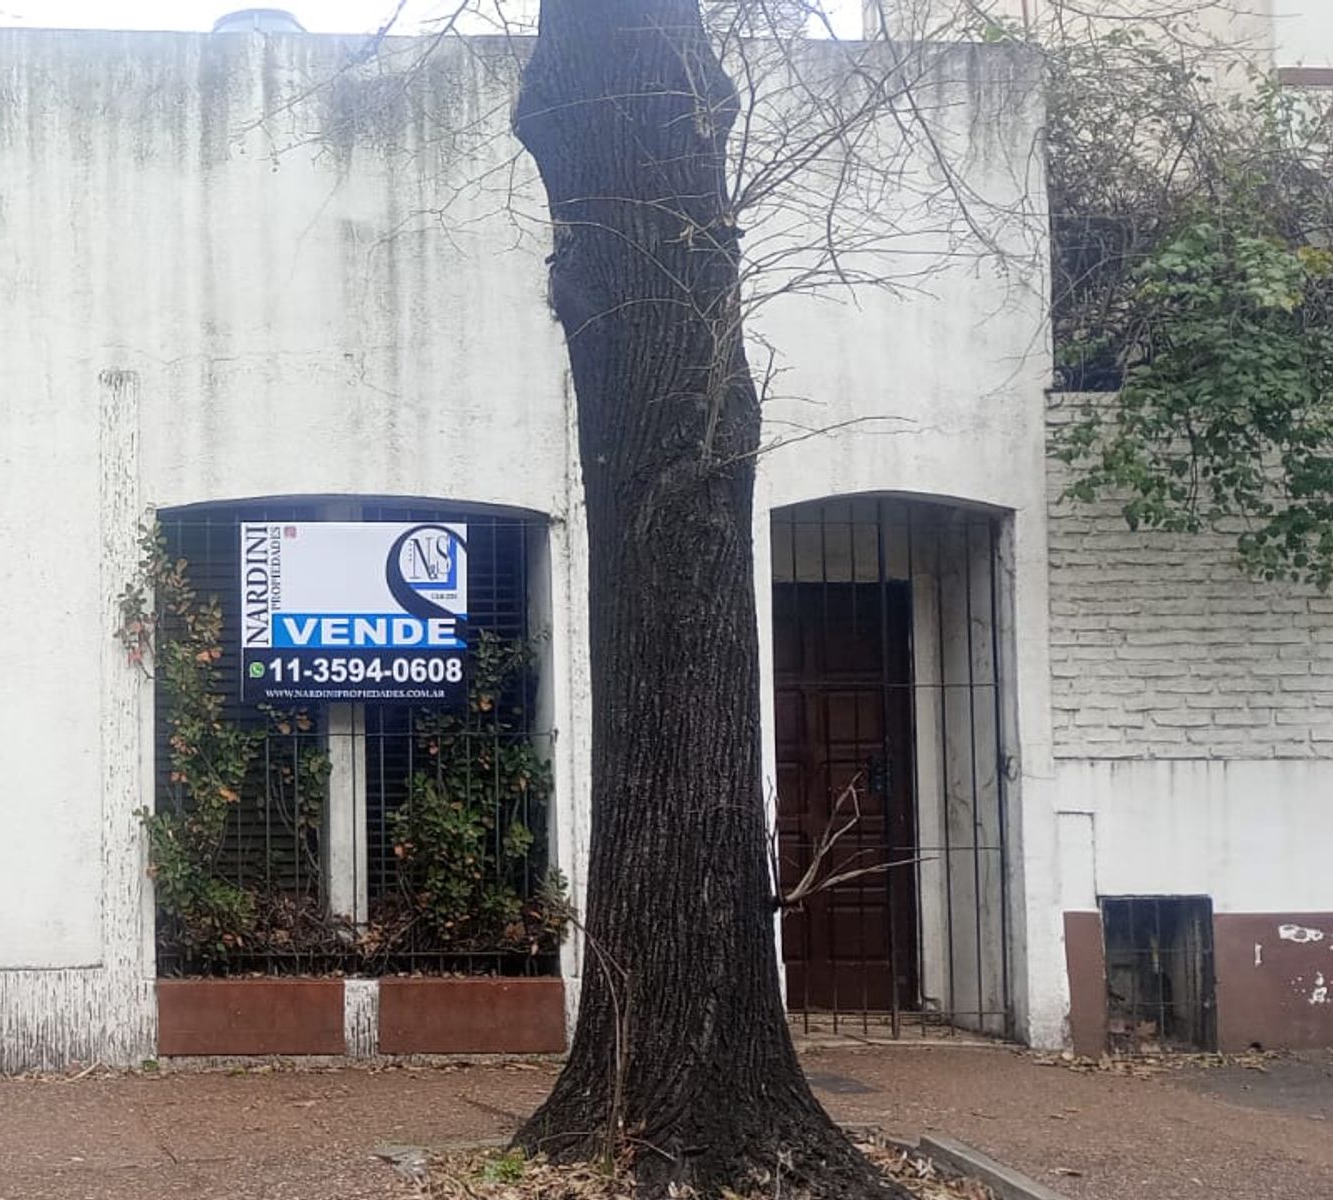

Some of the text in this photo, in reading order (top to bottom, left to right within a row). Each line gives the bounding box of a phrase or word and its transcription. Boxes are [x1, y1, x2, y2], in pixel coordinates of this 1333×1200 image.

[246, 526, 269, 645] NARDINI
[270, 526, 281, 611] PROPIEDADES
[282, 618, 457, 645] VENDE
[269, 657, 463, 683] 11-3594-0608
